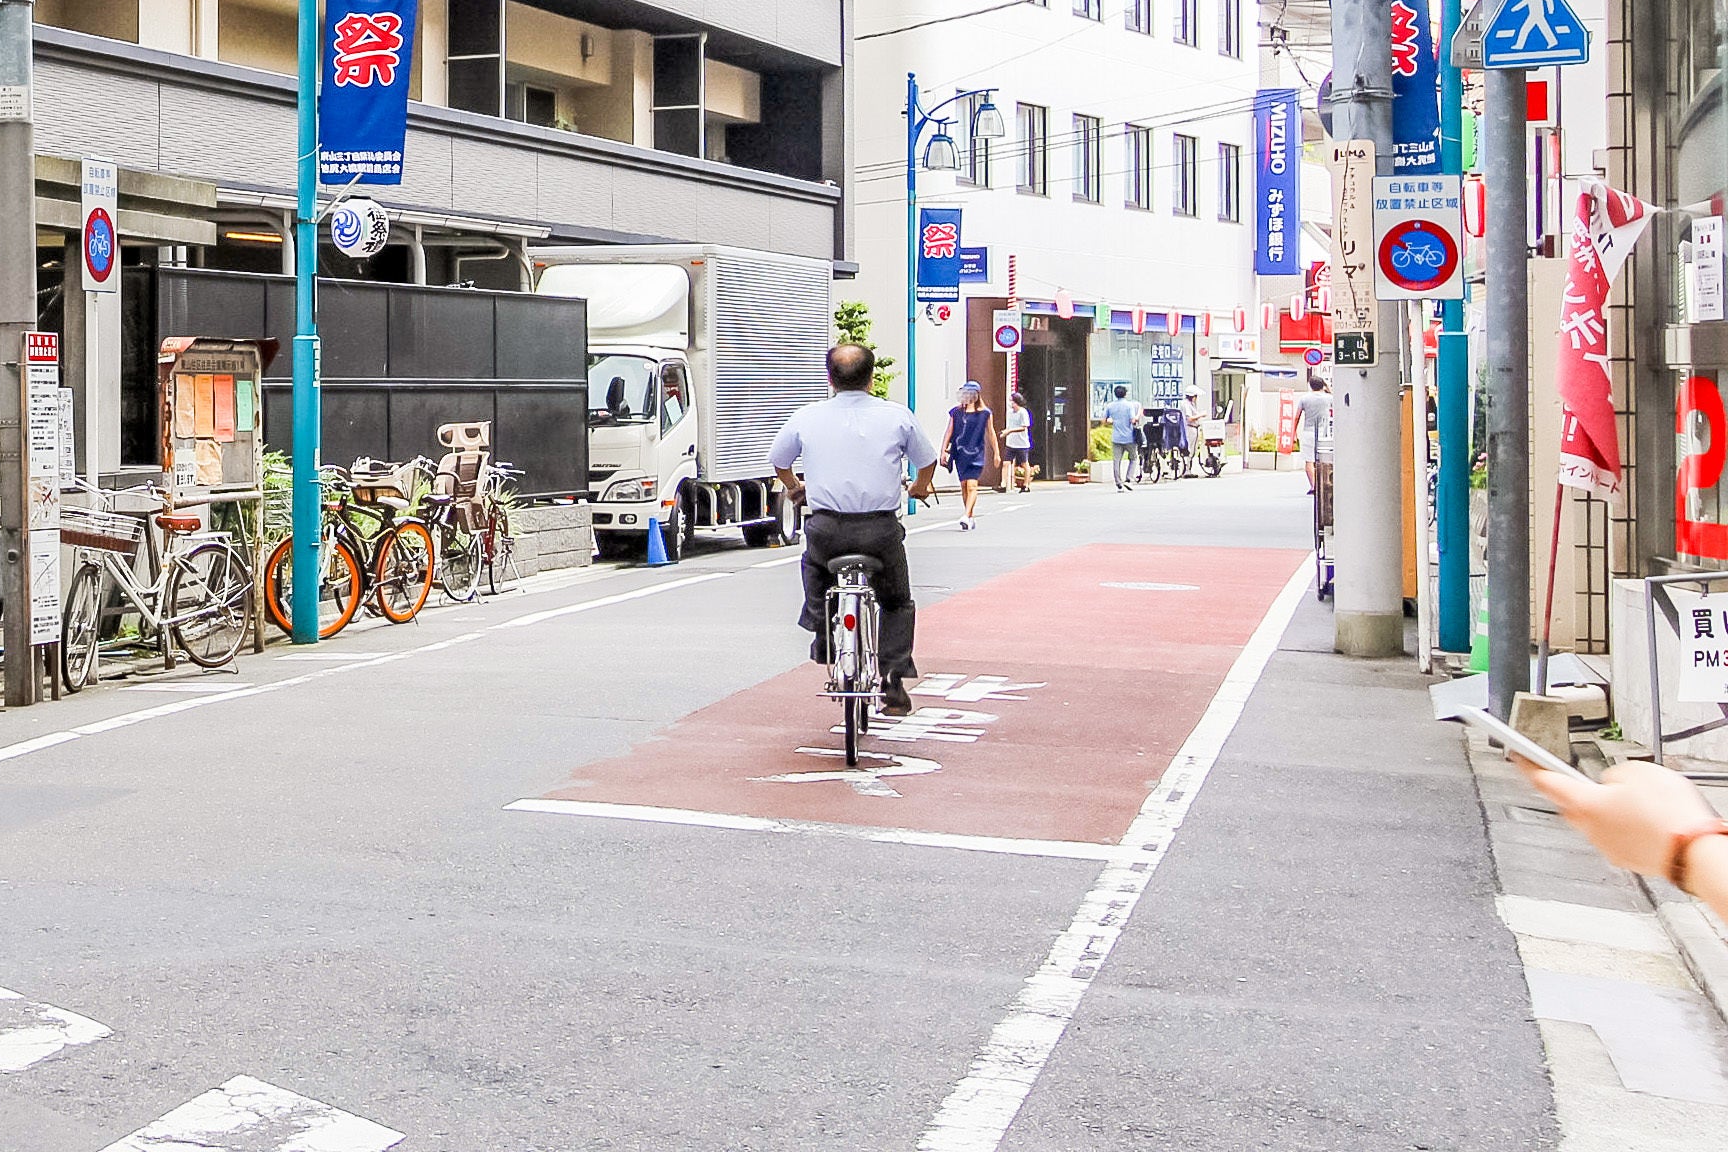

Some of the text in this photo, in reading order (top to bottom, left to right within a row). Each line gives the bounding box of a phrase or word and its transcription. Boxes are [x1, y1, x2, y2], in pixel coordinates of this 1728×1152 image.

[333, 12, 404, 88] 祭
[1270, 101, 1287, 175] MIZUHO
[1375, 198, 1459, 210] 放置禁止区域
[1389, 182, 1444, 194] 自転車等
[923, 223, 958, 258] 祭
[1268, 188, 1284, 262] みずほ銀行
